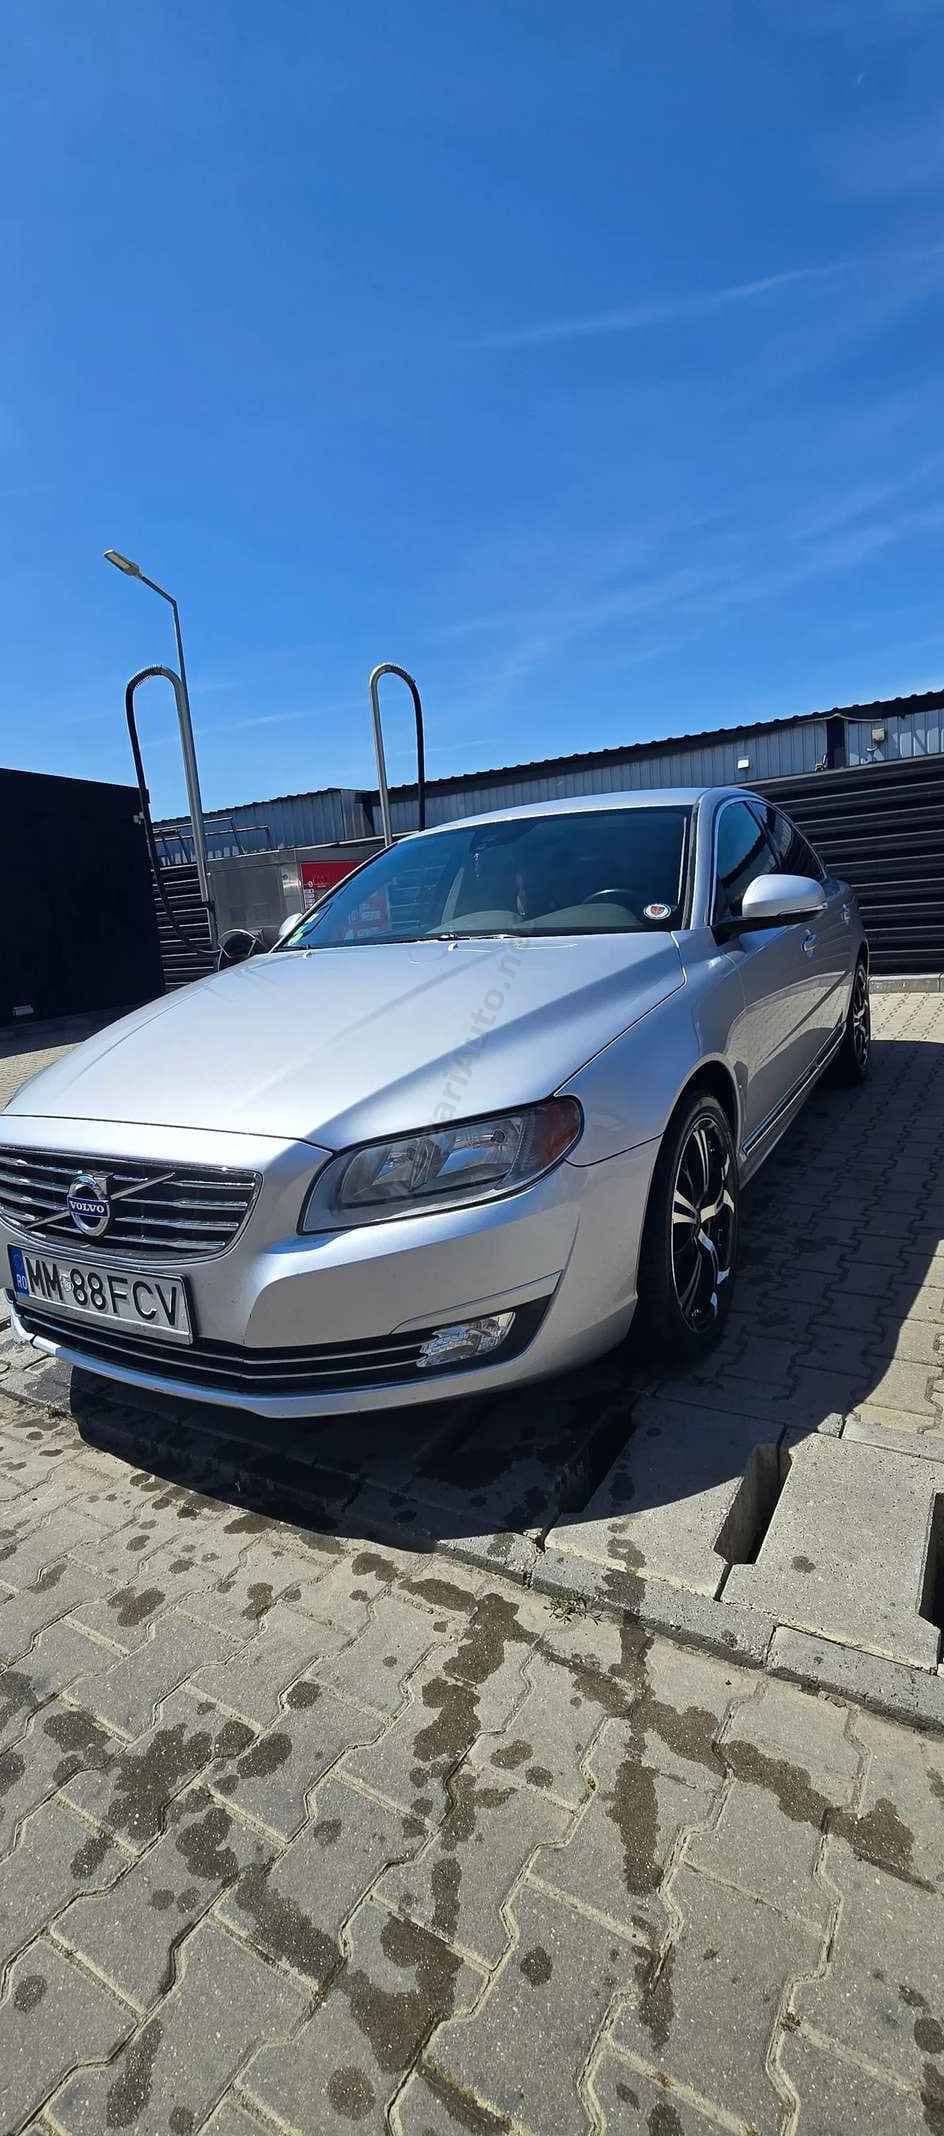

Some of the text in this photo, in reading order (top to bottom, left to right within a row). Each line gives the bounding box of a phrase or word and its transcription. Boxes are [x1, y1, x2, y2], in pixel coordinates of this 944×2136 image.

[69, 1200, 105, 1214] VOLVO
[16, 1274, 28, 1290] RO
[25, 1257, 177, 1326] MM 88FCV
